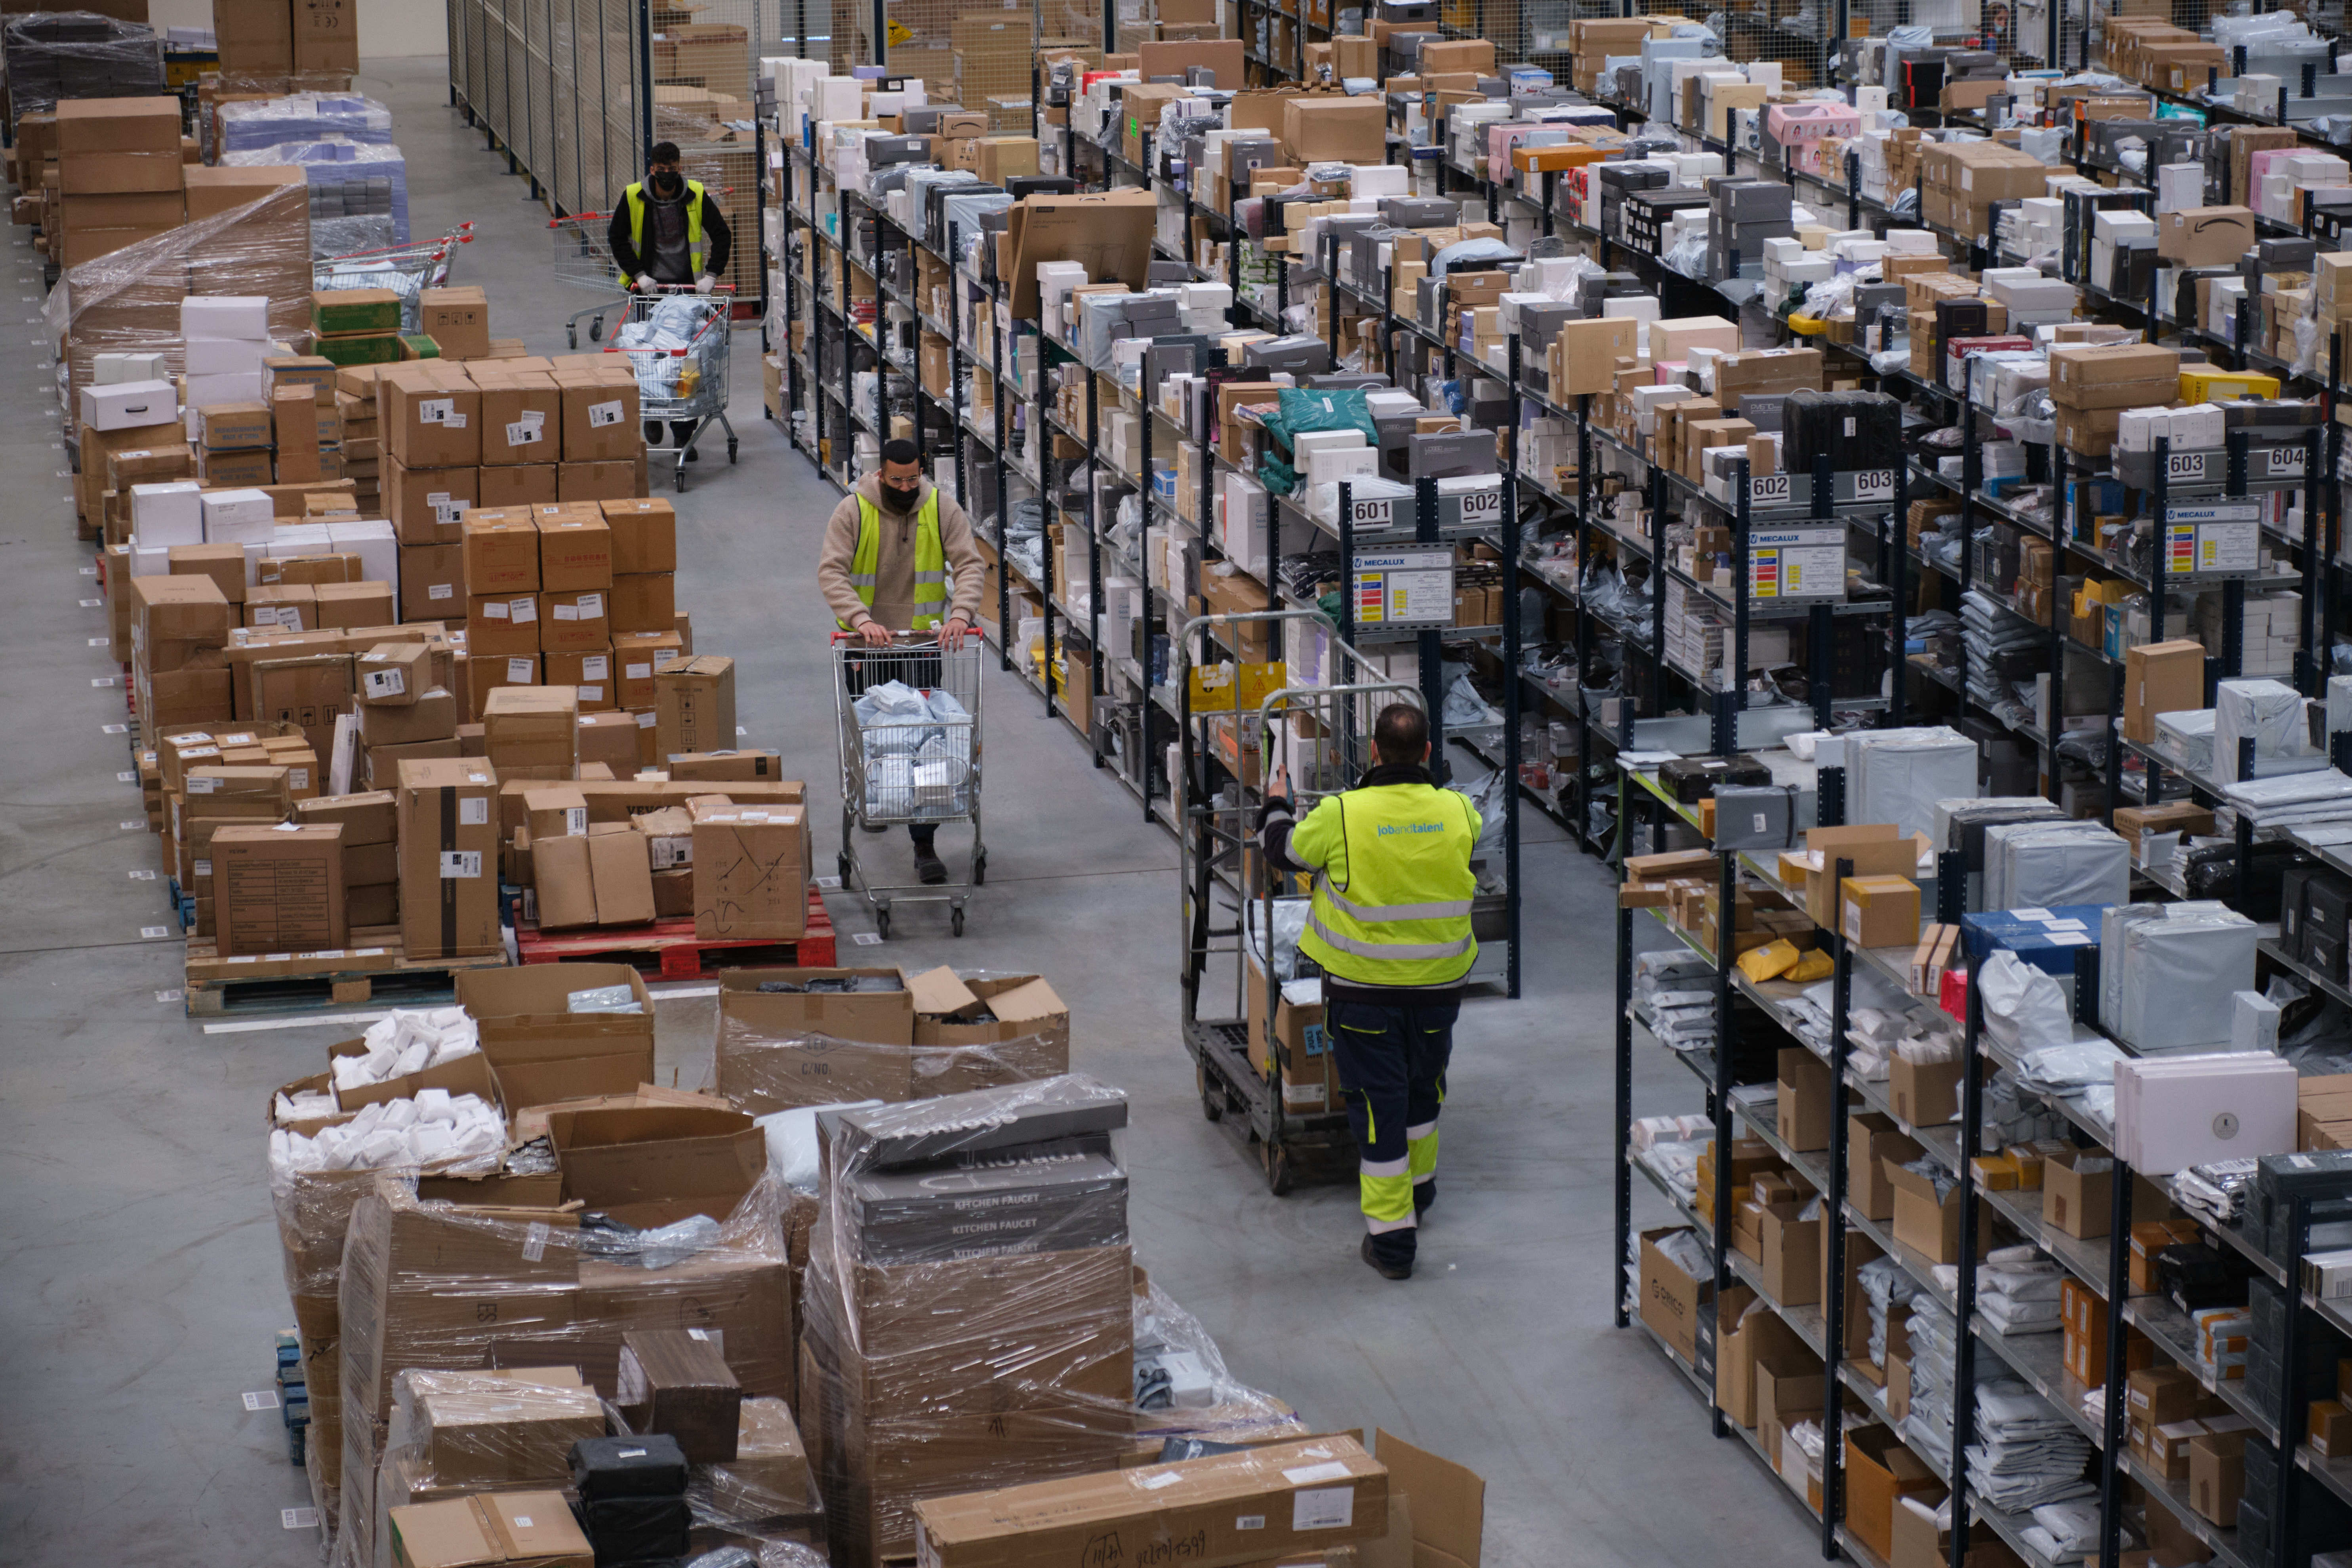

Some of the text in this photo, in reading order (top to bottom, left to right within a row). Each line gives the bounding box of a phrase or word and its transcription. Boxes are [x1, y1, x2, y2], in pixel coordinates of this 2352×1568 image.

[2171, 455, 2203, 472] 603
[2272, 449, 2304, 465] 604
[1754, 477, 1788, 496] 602
[1858, 470, 1892, 490] 603
[1355, 502, 1389, 520] 601
[1464, 493, 1498, 513] 602
[1364, 558, 1405, 567] MECALUX
[1378, 821, 1444, 837] jobandtalent
[807, 1038, 827, 1050] LED
[954, 1194, 1039, 1210] KITCHEN FAUCET
[952, 1218, 1038, 1235] KITCHEN FAUCET
[954, 1243, 1039, 1260] KITCHEN FAUCET
[1660, 1286, 1684, 1316] ORICO
